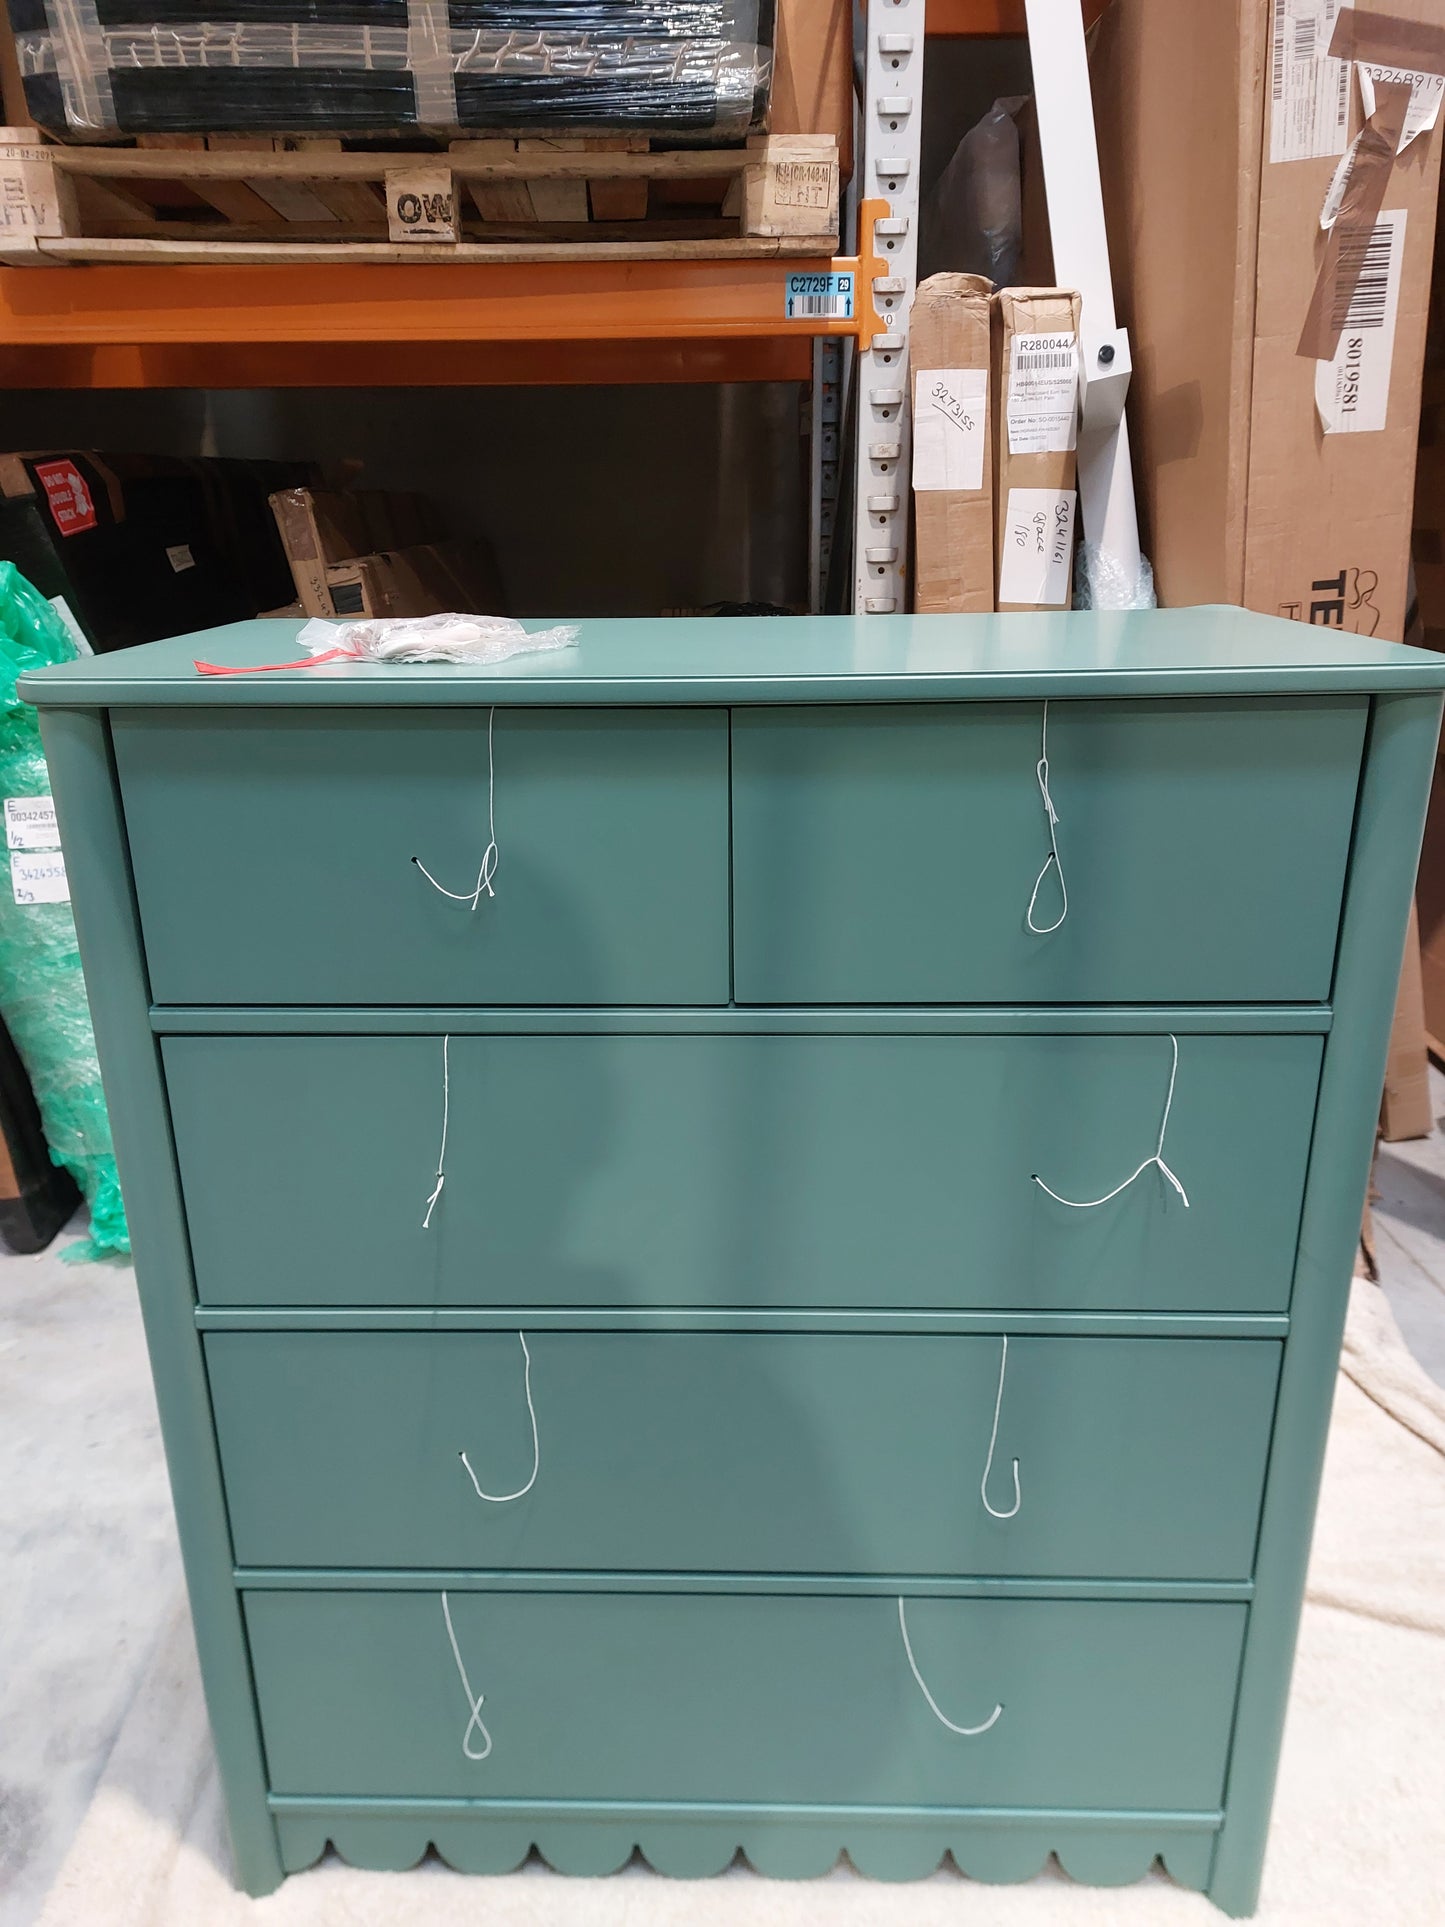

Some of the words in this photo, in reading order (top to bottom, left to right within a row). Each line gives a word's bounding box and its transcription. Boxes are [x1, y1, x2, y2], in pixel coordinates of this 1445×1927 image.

[790, 276, 834, 293] C2729F
[838, 278, 850, 291] 29
[1020, 339, 1069, 351] R280044
[1341, 338, 1363, 413] 8019581
[1052, 500, 1069, 564] 3241161
[1309, 569, 1347, 631] TE
